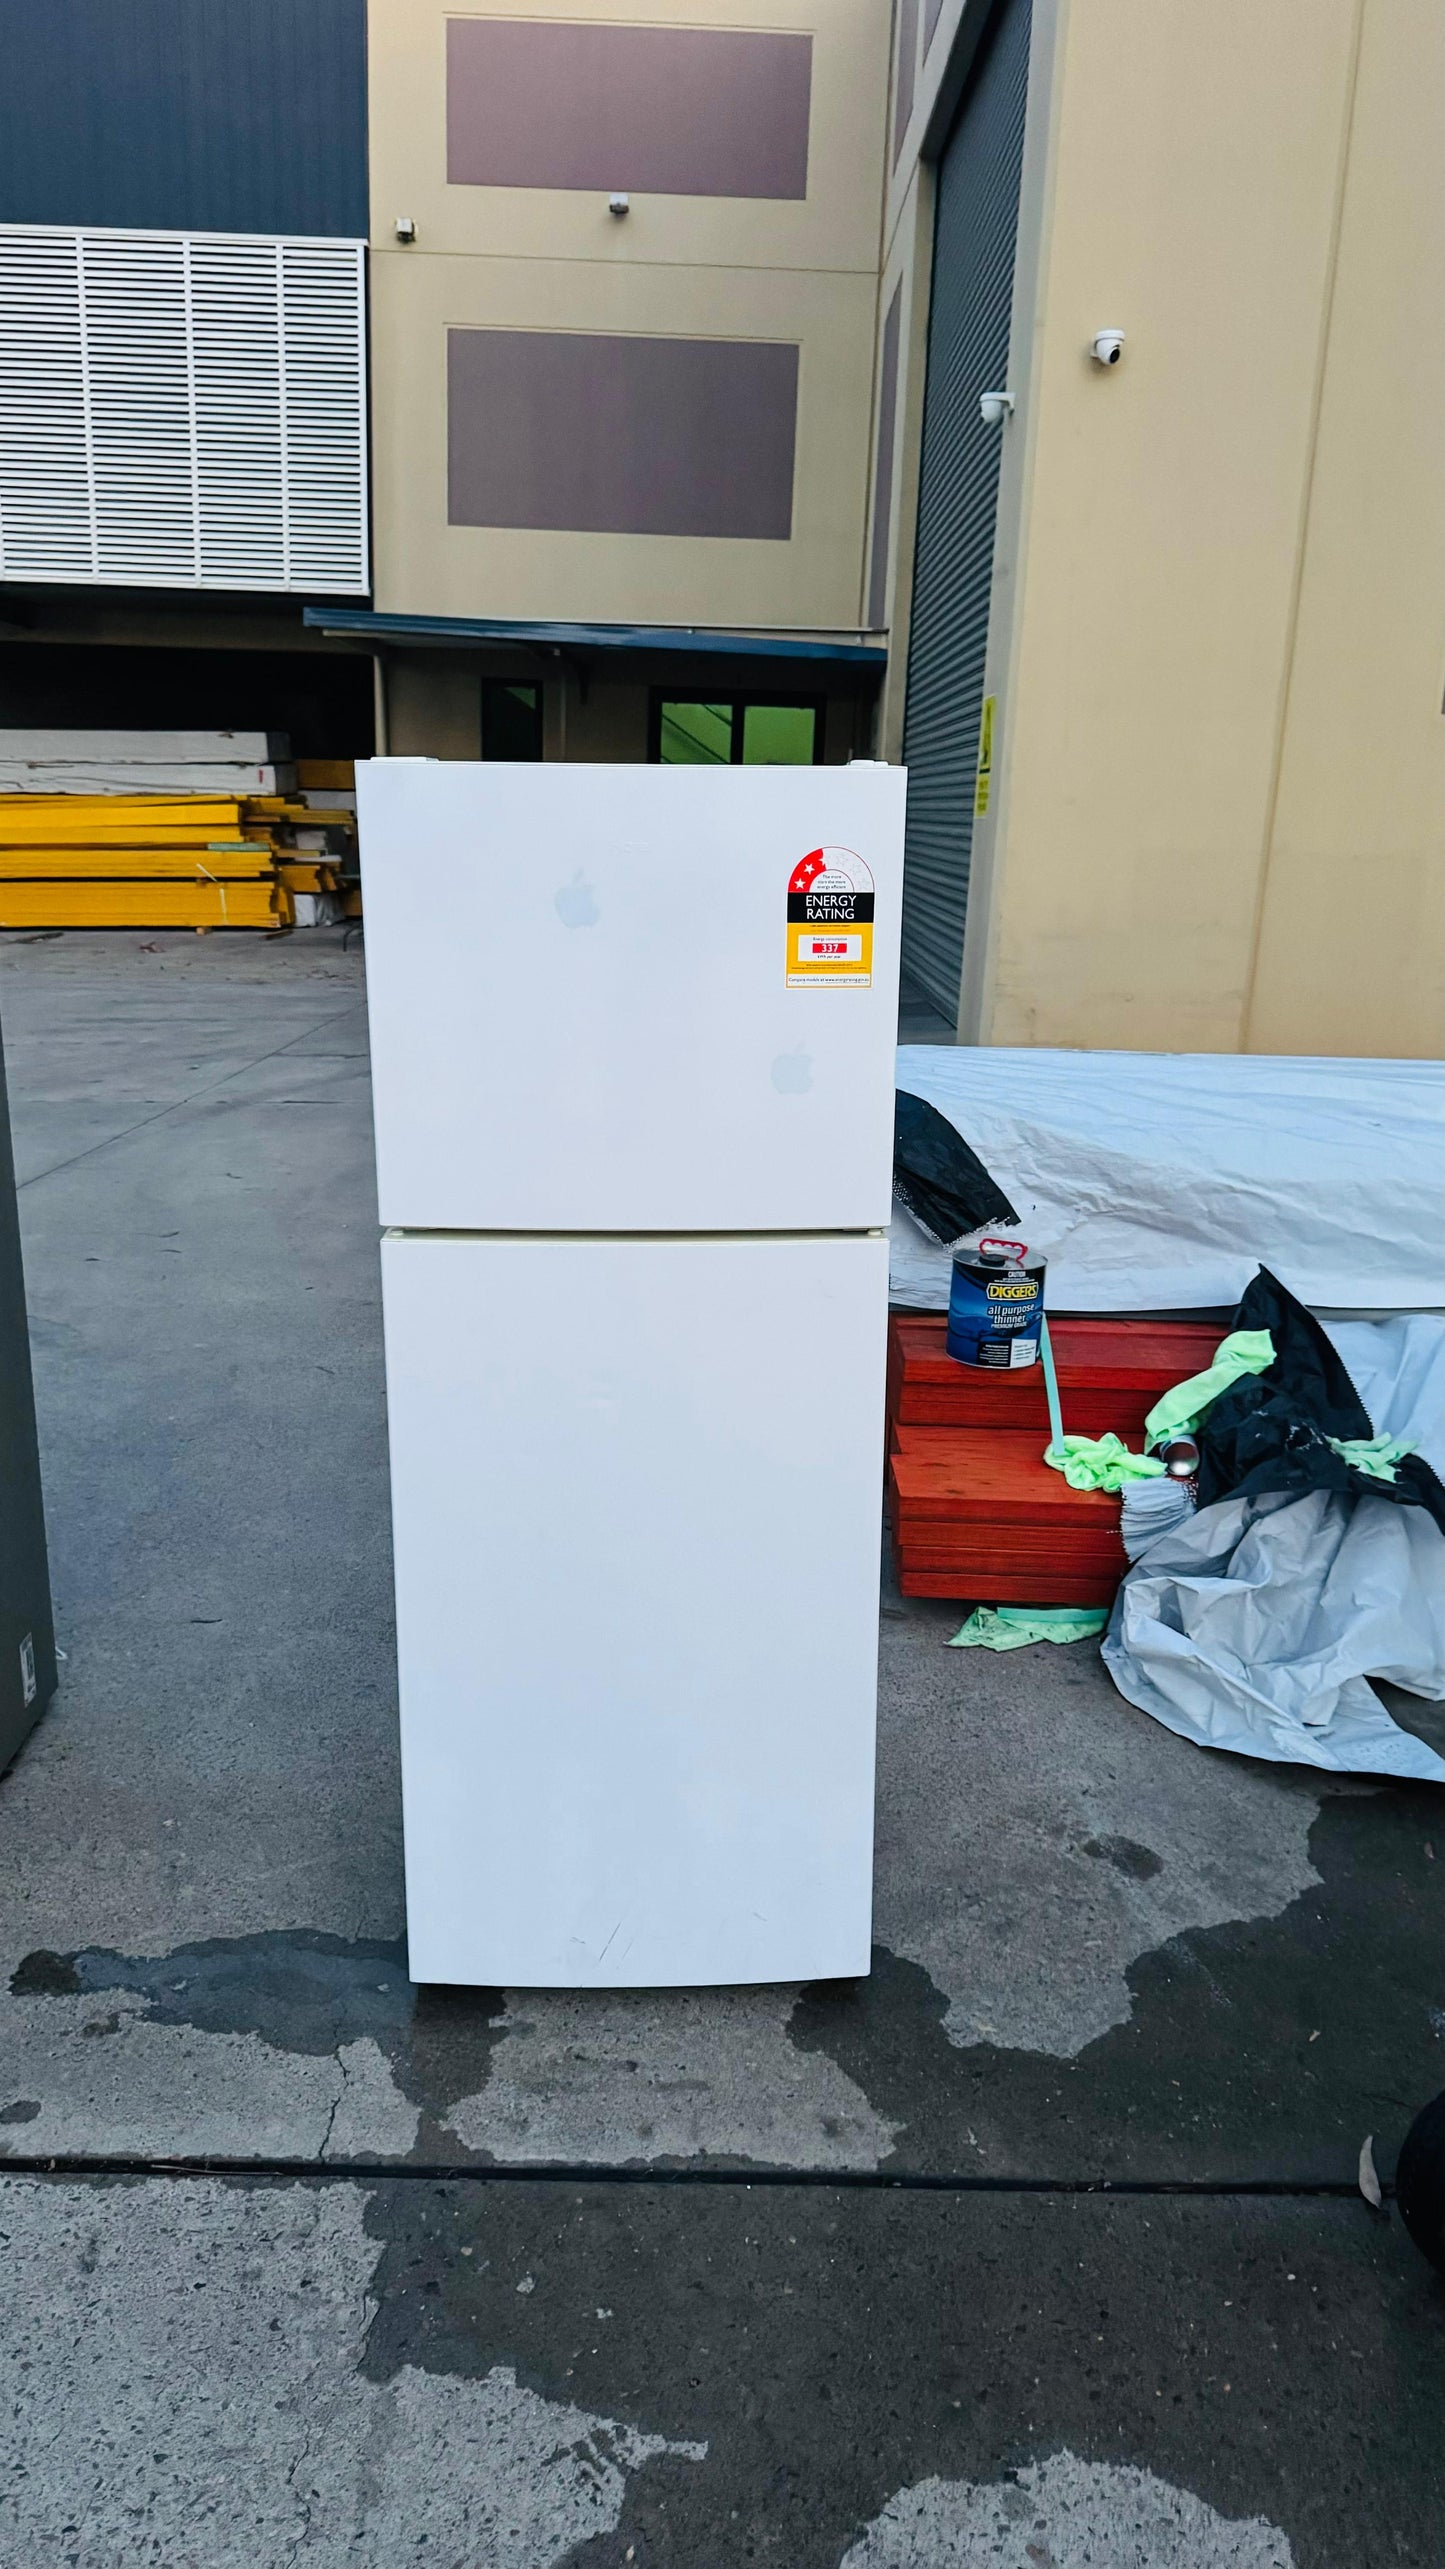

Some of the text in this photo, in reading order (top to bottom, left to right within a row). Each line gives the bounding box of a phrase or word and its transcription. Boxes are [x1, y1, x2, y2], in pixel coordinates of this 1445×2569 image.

[806, 895, 857, 907] ENERGY
[806, 908, 855, 920] RATING
[821, 944, 838, 953] 337
[989, 1285, 1037, 1298] DIGGERS
[988, 1303, 1035, 1317] all purpose
[994, 1314, 1026, 1324] thinner
